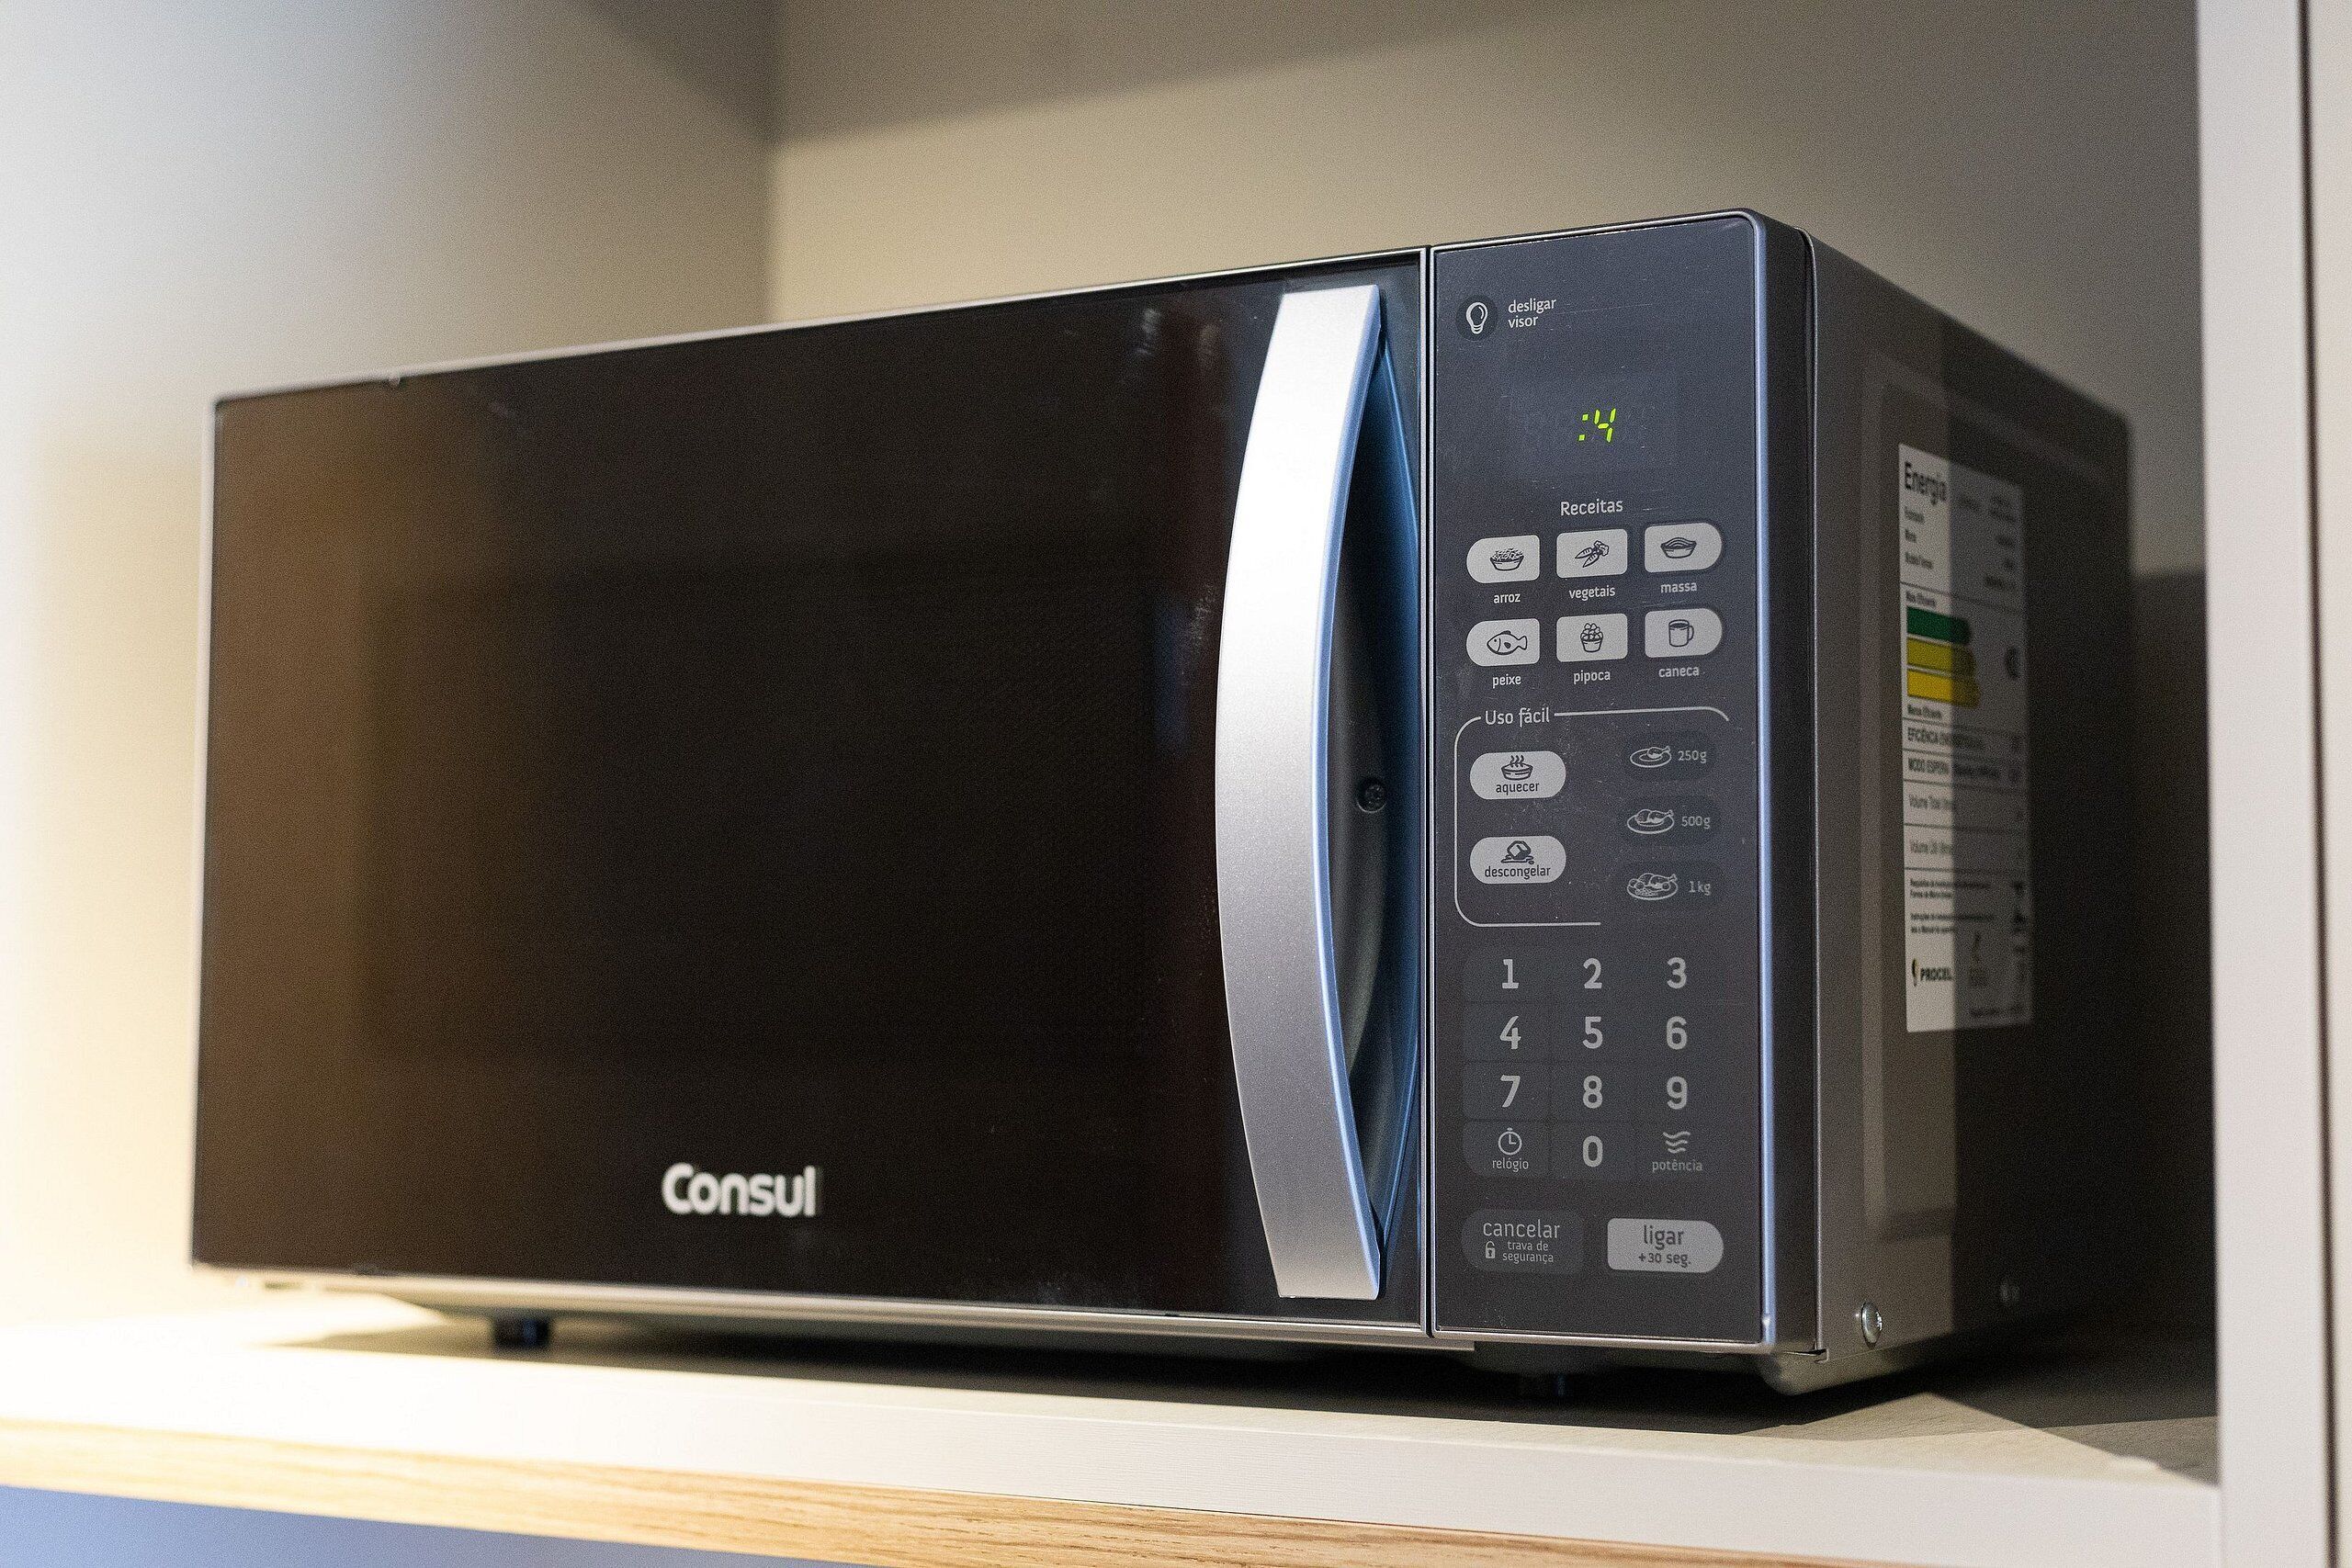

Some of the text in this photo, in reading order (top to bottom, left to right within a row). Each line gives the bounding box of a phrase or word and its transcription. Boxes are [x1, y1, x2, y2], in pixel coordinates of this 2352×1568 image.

[1508, 297, 1556, 315] desligar
[1508, 314, 1539, 328] visor
[1561, 498, 1623, 516] Receitas
[1568, 585, 1616, 601] vegetais
[1660, 581, 1697, 593] massa
[1493, 592, 1521, 604] arroz
[1573, 669, 1611, 684] pipoca
[1658, 665, 1700, 678] caneca
[1492, 673, 1521, 688] peixe
[1485, 707, 1550, 728] Uso fácil
[1678, 750, 1707, 763] 250g
[1495, 782, 1540, 795] aquecer
[1681, 816, 1711, 829] 500g
[1485, 865, 1551, 880] descongelar
[1501, 959, 1520, 989] 1
[1582, 958, 1603, 989] 2
[1666, 957, 1687, 989] 3
[1499, 1015, 1521, 1049] 4
[1582, 1016, 1603, 1049] 5
[1666, 1016, 1688, 1050] 6
[1500, 1075, 1521, 1108] 7
[1582, 1076, 1603, 1109] 8
[1666, 1076, 1688, 1110] 9
[1582, 1135, 1604, 1168] 0
[1492, 1156, 1529, 1172] relógio
[1652, 1158, 1702, 1172] potência
[662, 1162, 817, 1217] Consul
[1482, 1219, 1560, 1239] cancelar
[1643, 1224, 1684, 1250] ligar
[1507, 1240, 1549, 1251] trava de
[1502, 1251, 1554, 1264] segurança
[1667, 1253, 1691, 1268] seg.
